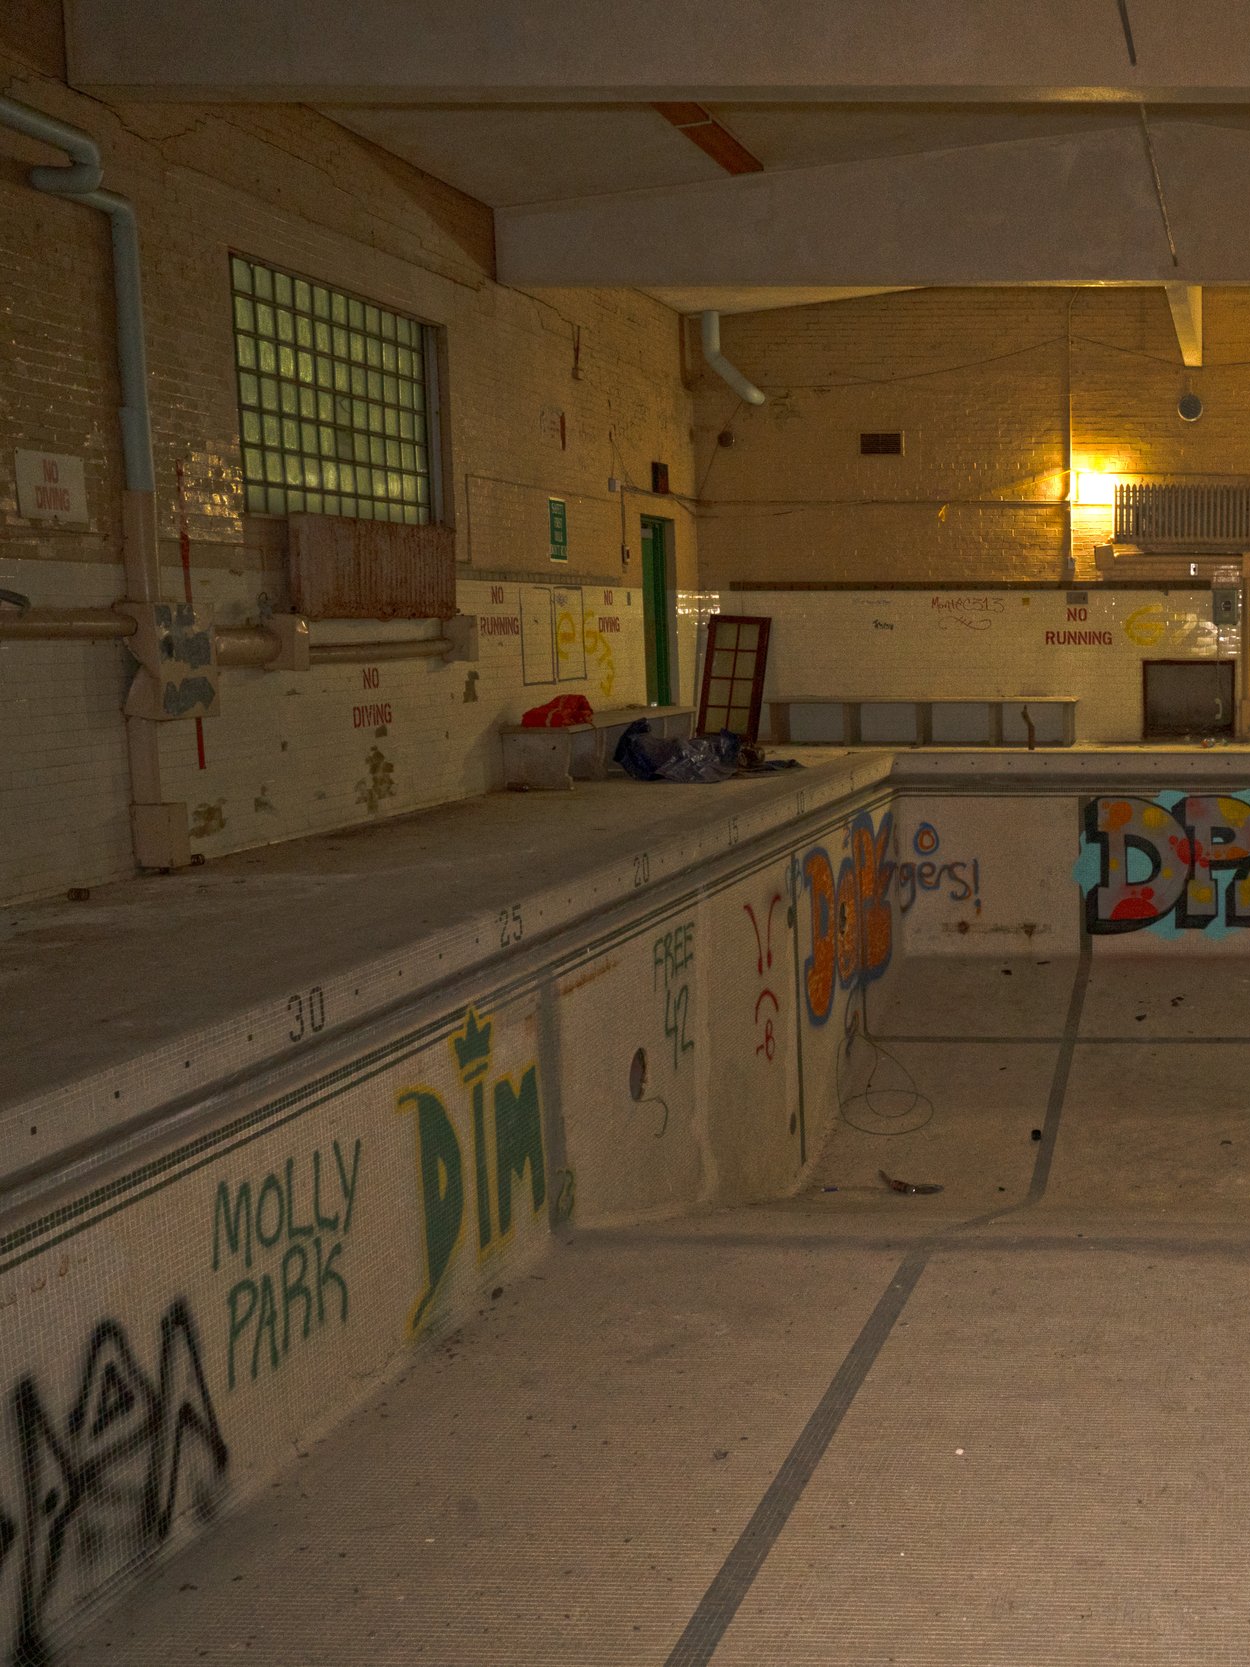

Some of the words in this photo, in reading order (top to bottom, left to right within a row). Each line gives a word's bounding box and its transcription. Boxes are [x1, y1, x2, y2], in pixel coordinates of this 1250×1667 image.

[43, 459, 59, 483] NO
[35, 486, 70, 512] DIVING
[491, 586, 504, 604] NO
[603, 589, 614, 606] NO
[480, 616, 520, 636] RUNNING
[598, 616, 621, 633] DIVING
[1067, 608, 1087, 622] NO
[1045, 631, 1113, 646] RUNNING
[363, 667, 379, 689] NO
[353, 703, 392, 728] DIVING
[727, 815, 739, 846] 15
[633, 852, 650, 887] 20
[499, 904, 523, 947] 25
[653, 922, 696, 992] FREE
[287, 986, 325, 1042] 30
[664, 984, 695, 1070] 42
[212, 1138, 362, 1272] MOLLY
[395, 1060, 548, 1342] DIM
[227, 1236, 350, 1392] PARK
